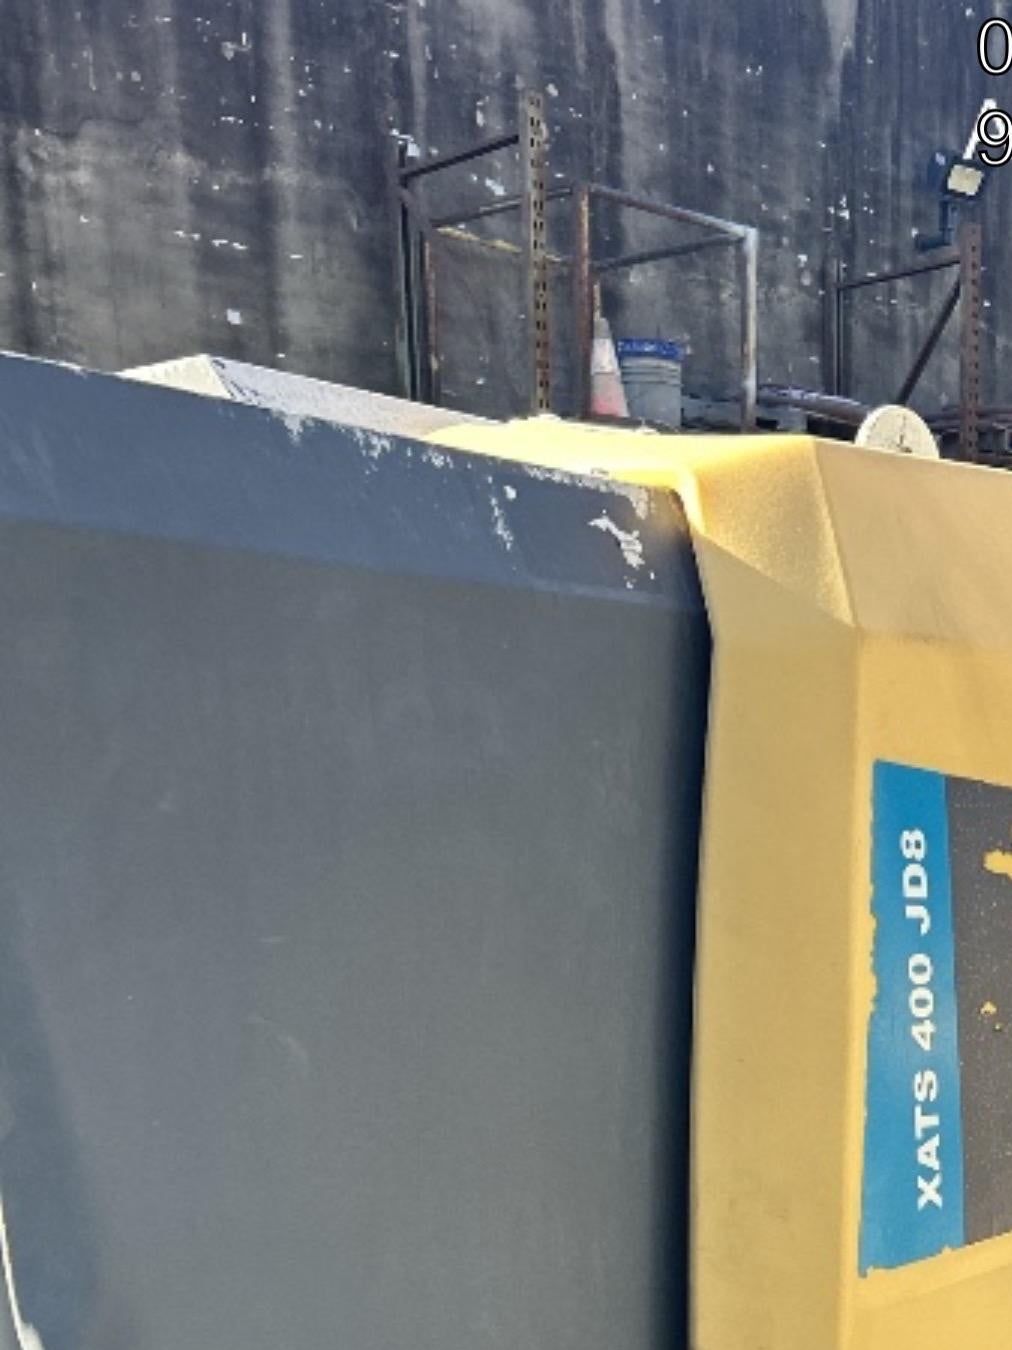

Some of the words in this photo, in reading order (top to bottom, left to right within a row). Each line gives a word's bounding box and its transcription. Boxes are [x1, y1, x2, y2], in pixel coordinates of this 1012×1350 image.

[899, 827, 931, 937] JD8
[908, 953, 935, 1052] 400
[913, 1070, 943, 1210] XATS
